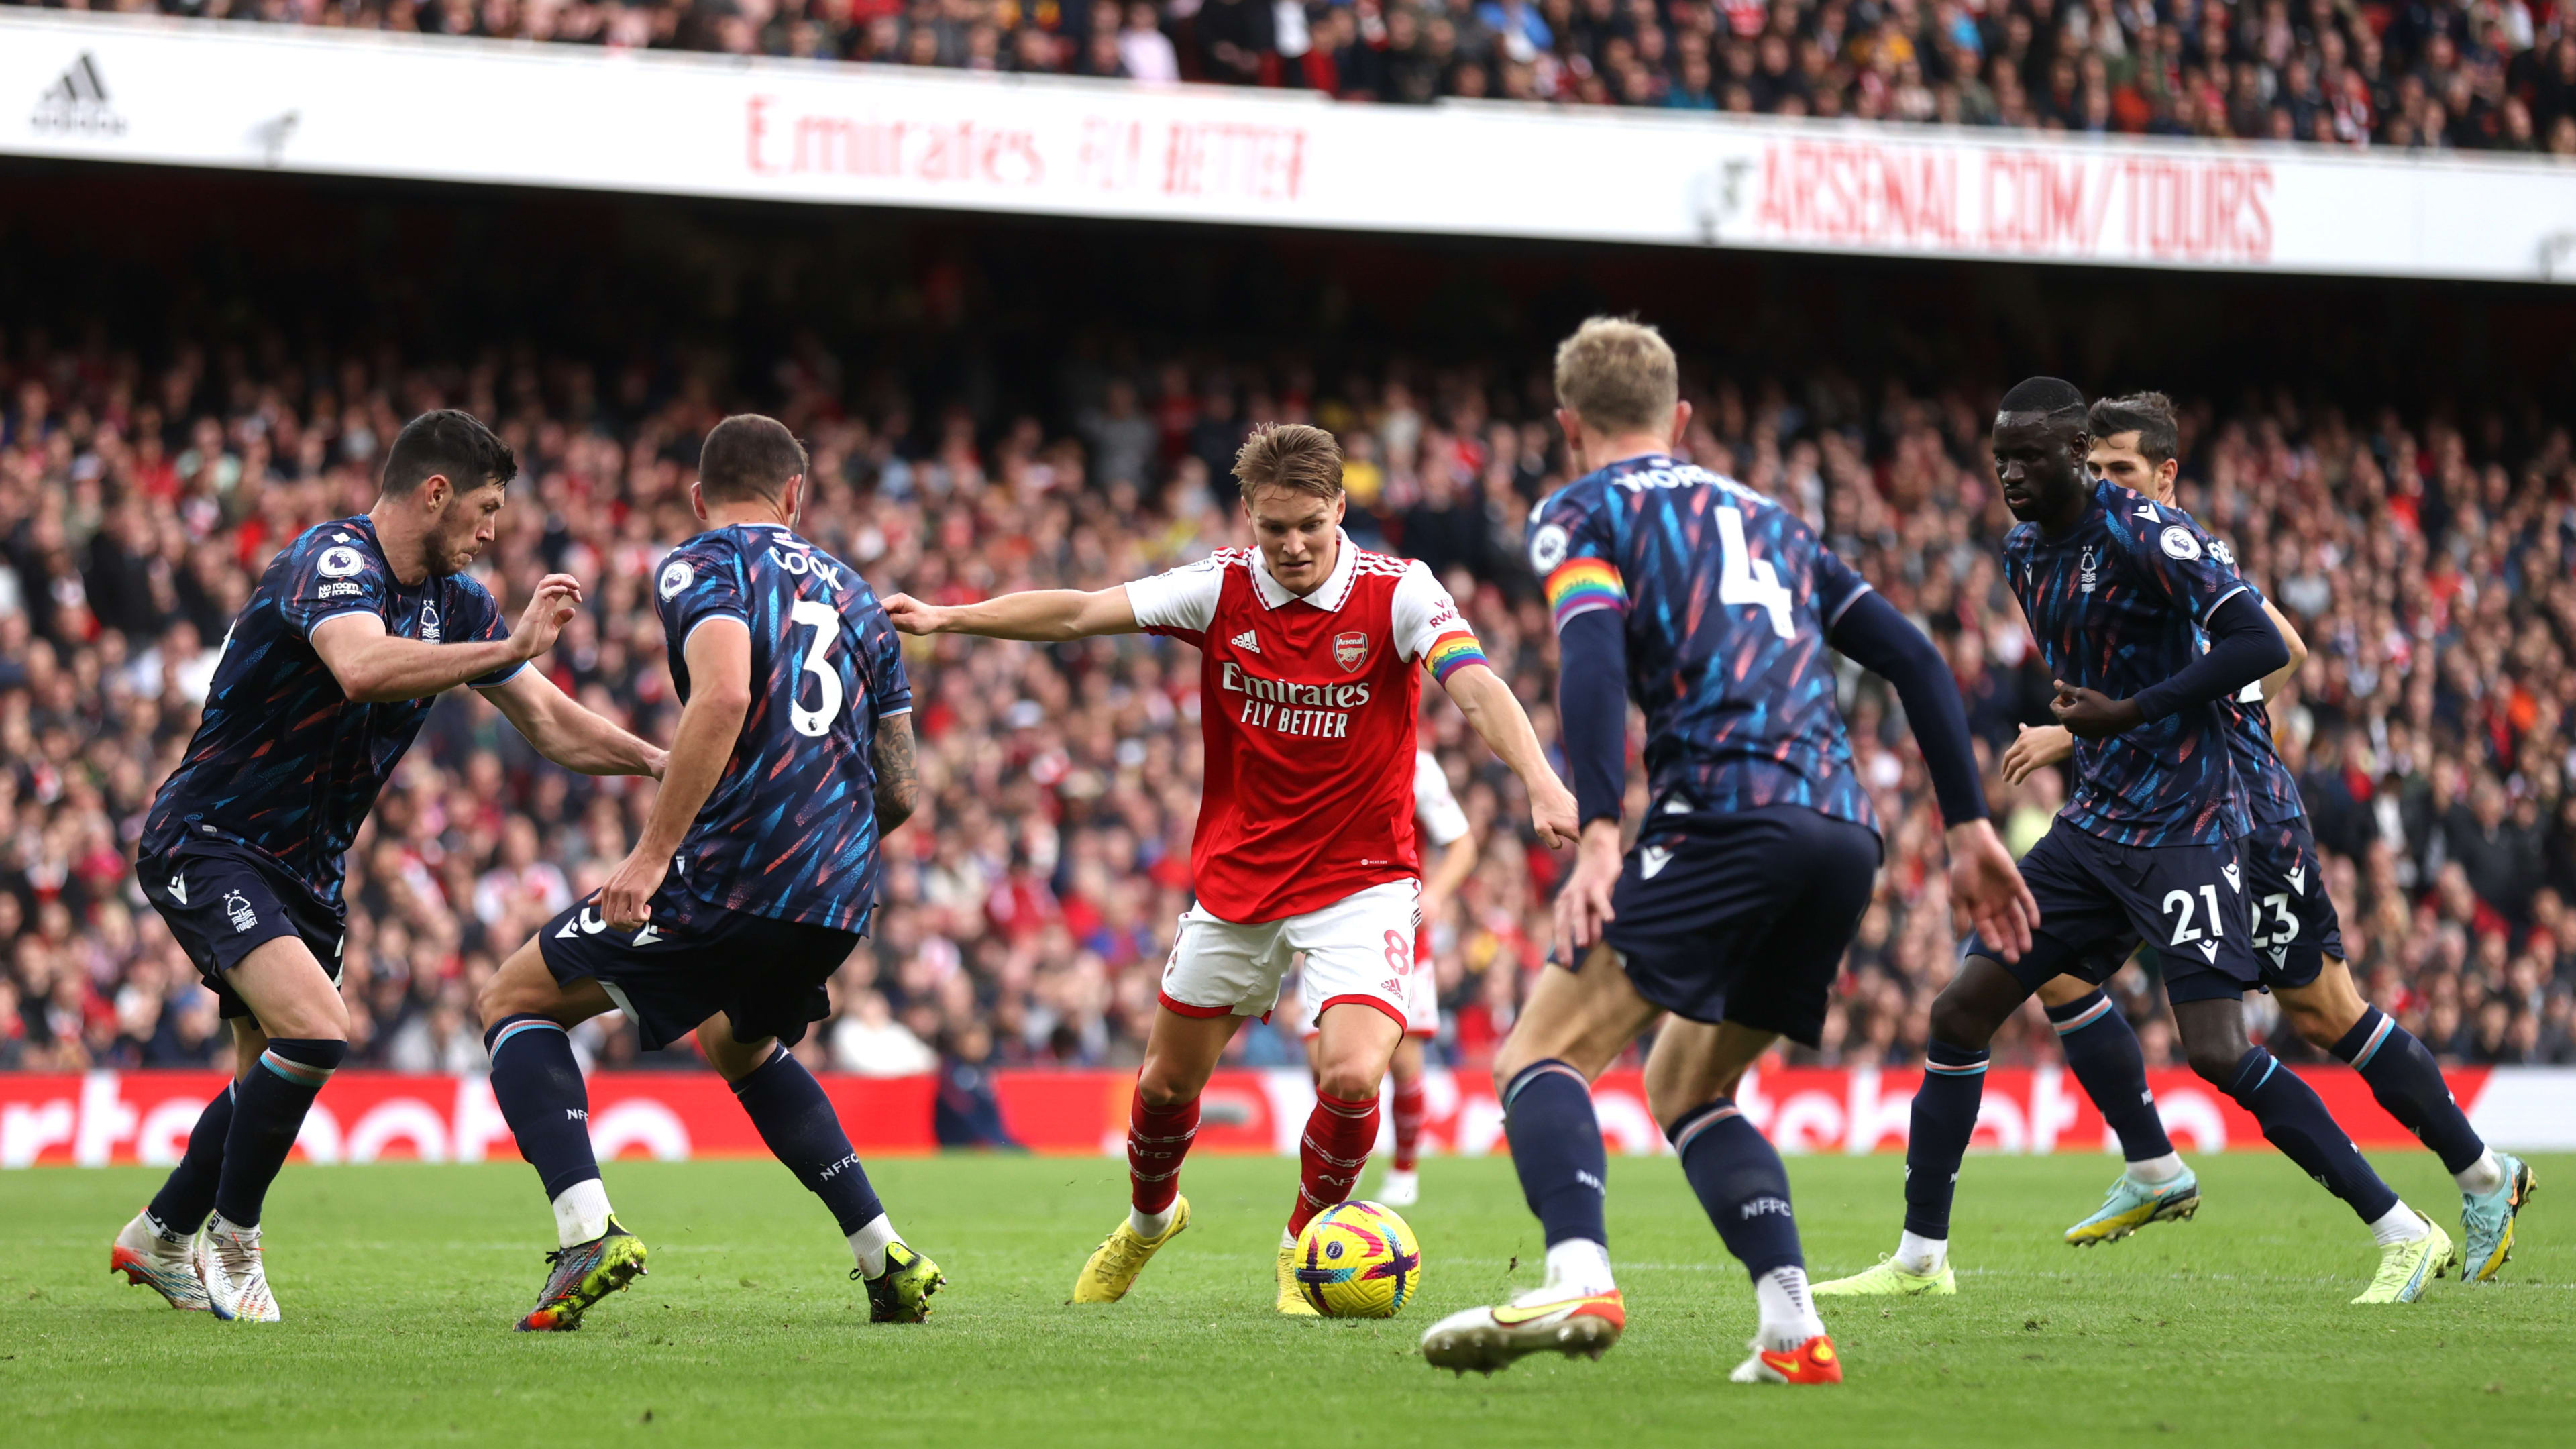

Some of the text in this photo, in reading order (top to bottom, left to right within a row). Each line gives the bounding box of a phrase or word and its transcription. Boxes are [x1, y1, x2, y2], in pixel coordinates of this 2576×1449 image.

[747, 93, 1046, 184] Emirates
[769, 546, 844, 591] COOK
[1715, 506, 1796, 639] 4
[318, 590, 330, 599] for
[319, 582, 358, 592] No room
[1230, 637, 1260, 654] adidas
[1338, 637, 1363, 645] Arsenal
[790, 598, 843, 737] 3
[1221, 662, 1370, 708] Emirates
[1241, 698, 1348, 738] FLY BETTER
[236, 916, 258, 933] FOREST
[2163, 884, 2224, 946] 21
[1384, 929, 1409, 975] 8
[1381, 983, 1403, 1001] adidas
[820, 1152, 859, 1181] NFFC
[1741, 1197, 1792, 1220] NFFC
